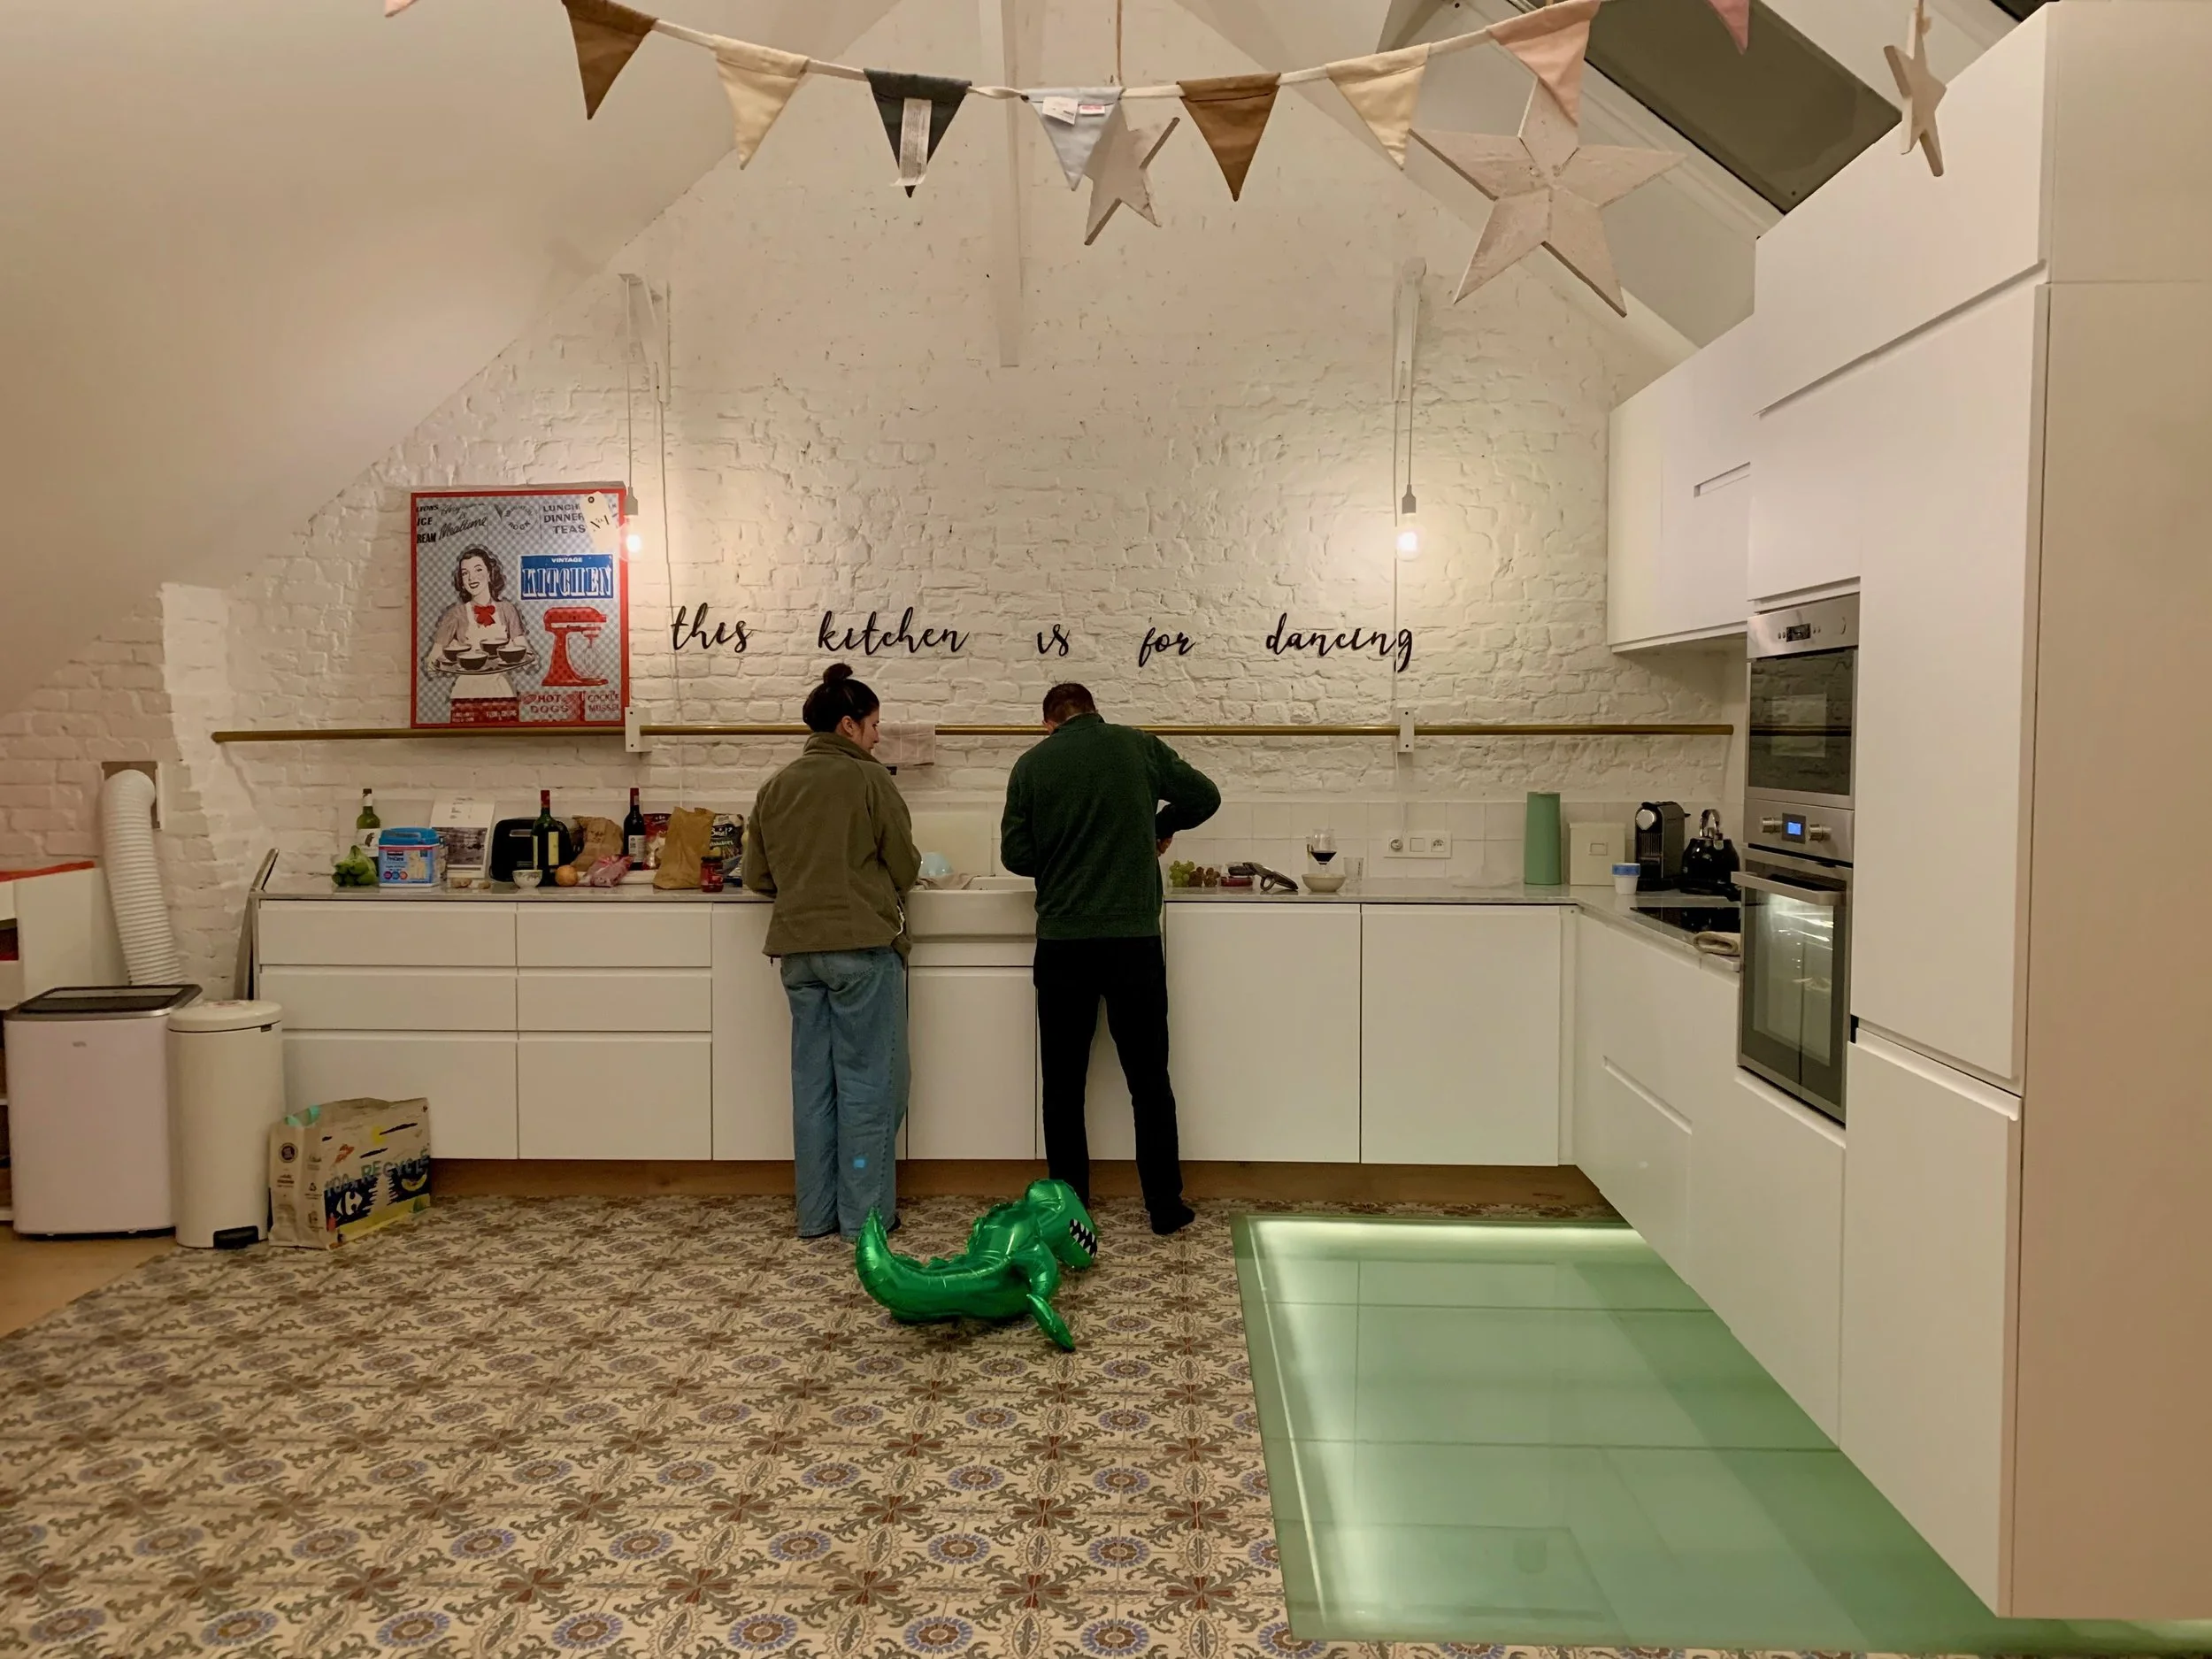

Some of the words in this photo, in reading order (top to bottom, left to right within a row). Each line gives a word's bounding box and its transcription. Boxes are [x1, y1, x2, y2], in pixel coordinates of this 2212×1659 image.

[416, 517, 433, 526] ICE
[508, 520, 531, 530] ROCK
[552, 524, 586, 534] TEAS
[416, 532, 437, 543] REAM
[522, 566, 612, 597] KITCHEN
[670, 603, 753, 653] this
[818, 606, 970, 656] kitchen
[1036, 623, 1070, 657] is
[1138, 618, 1196, 668] for
[1265, 612, 1414, 673] dancing
[537, 694, 562, 703] HOT
